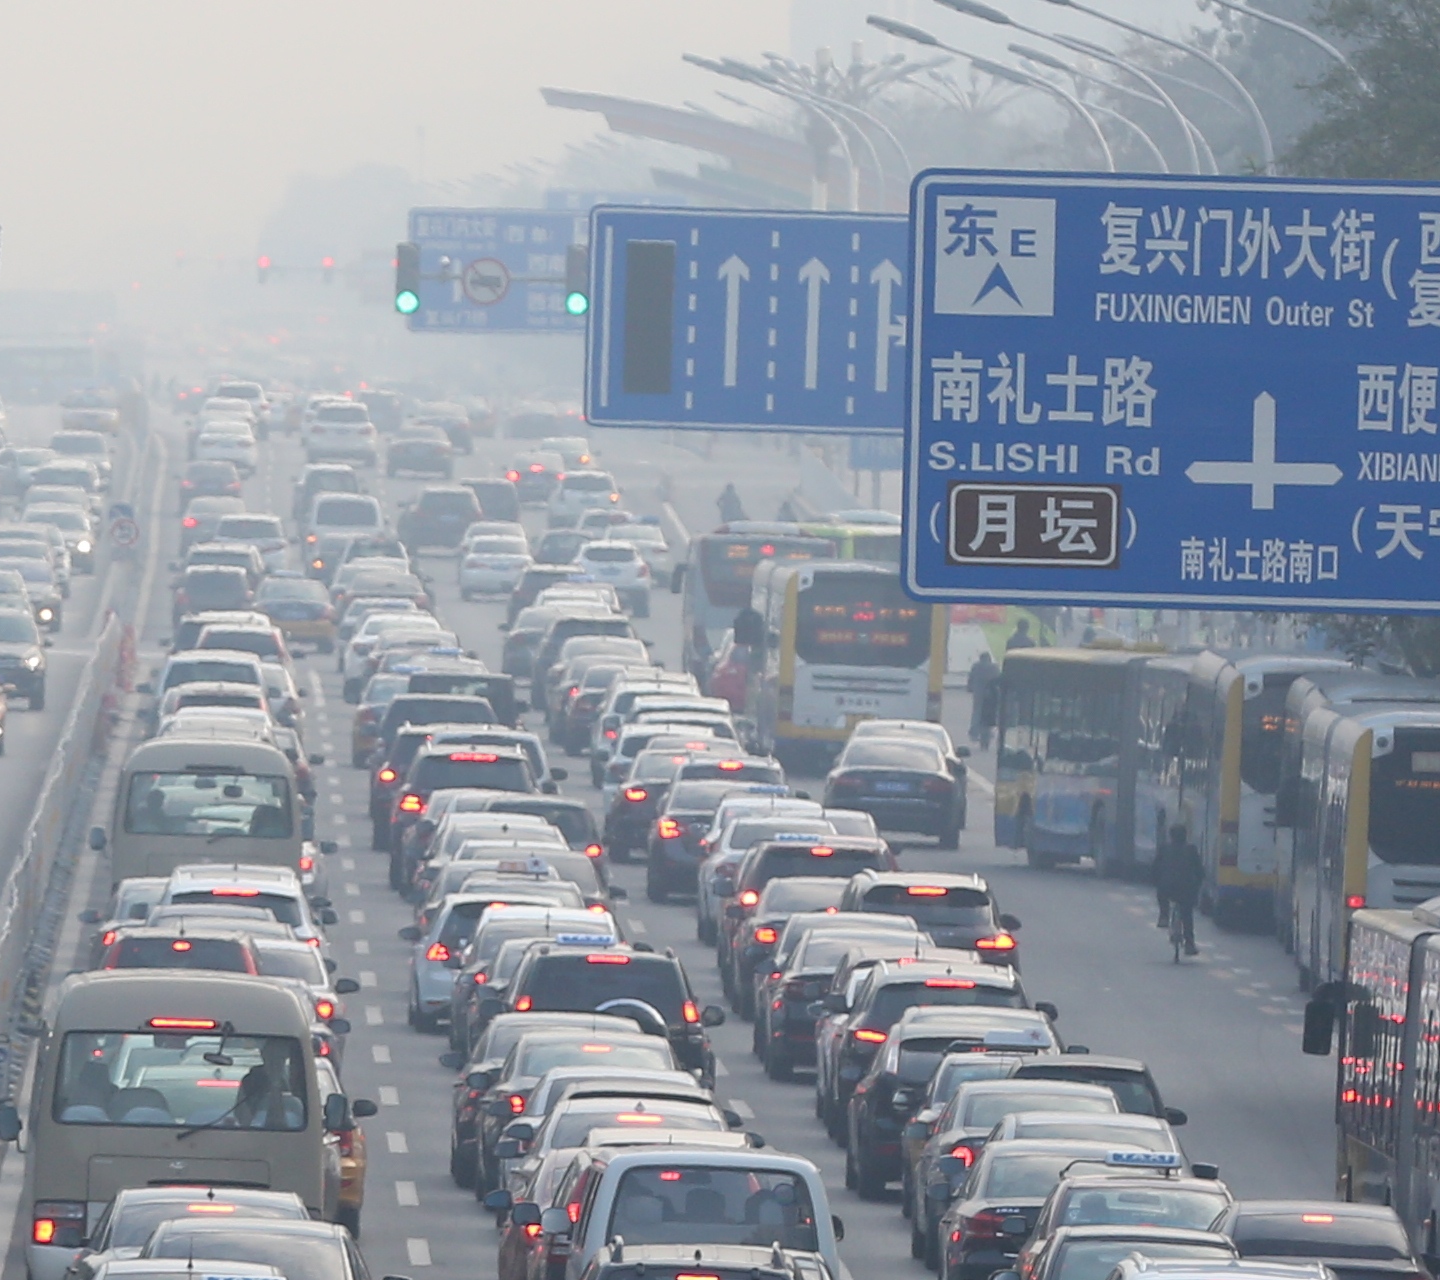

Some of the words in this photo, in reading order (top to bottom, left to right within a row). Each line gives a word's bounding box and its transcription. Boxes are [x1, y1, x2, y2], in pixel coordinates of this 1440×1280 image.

[944, 203, 998, 257] 东
[1010, 228, 1038, 258] E
[1099, 202, 1376, 281] 复兴门外大街
[1095, 292, 1251, 325] FUXINGMEN
[1266, 296, 1334, 327] Outer
[1348, 298, 1375, 328] St
[931, 350, 1158, 428] 南礼士路
[928, 441, 1078, 474] S.LISHI
[1105, 445, 1160, 476] Rd
[1180, 535, 1339, 584] 南礼士路南口
